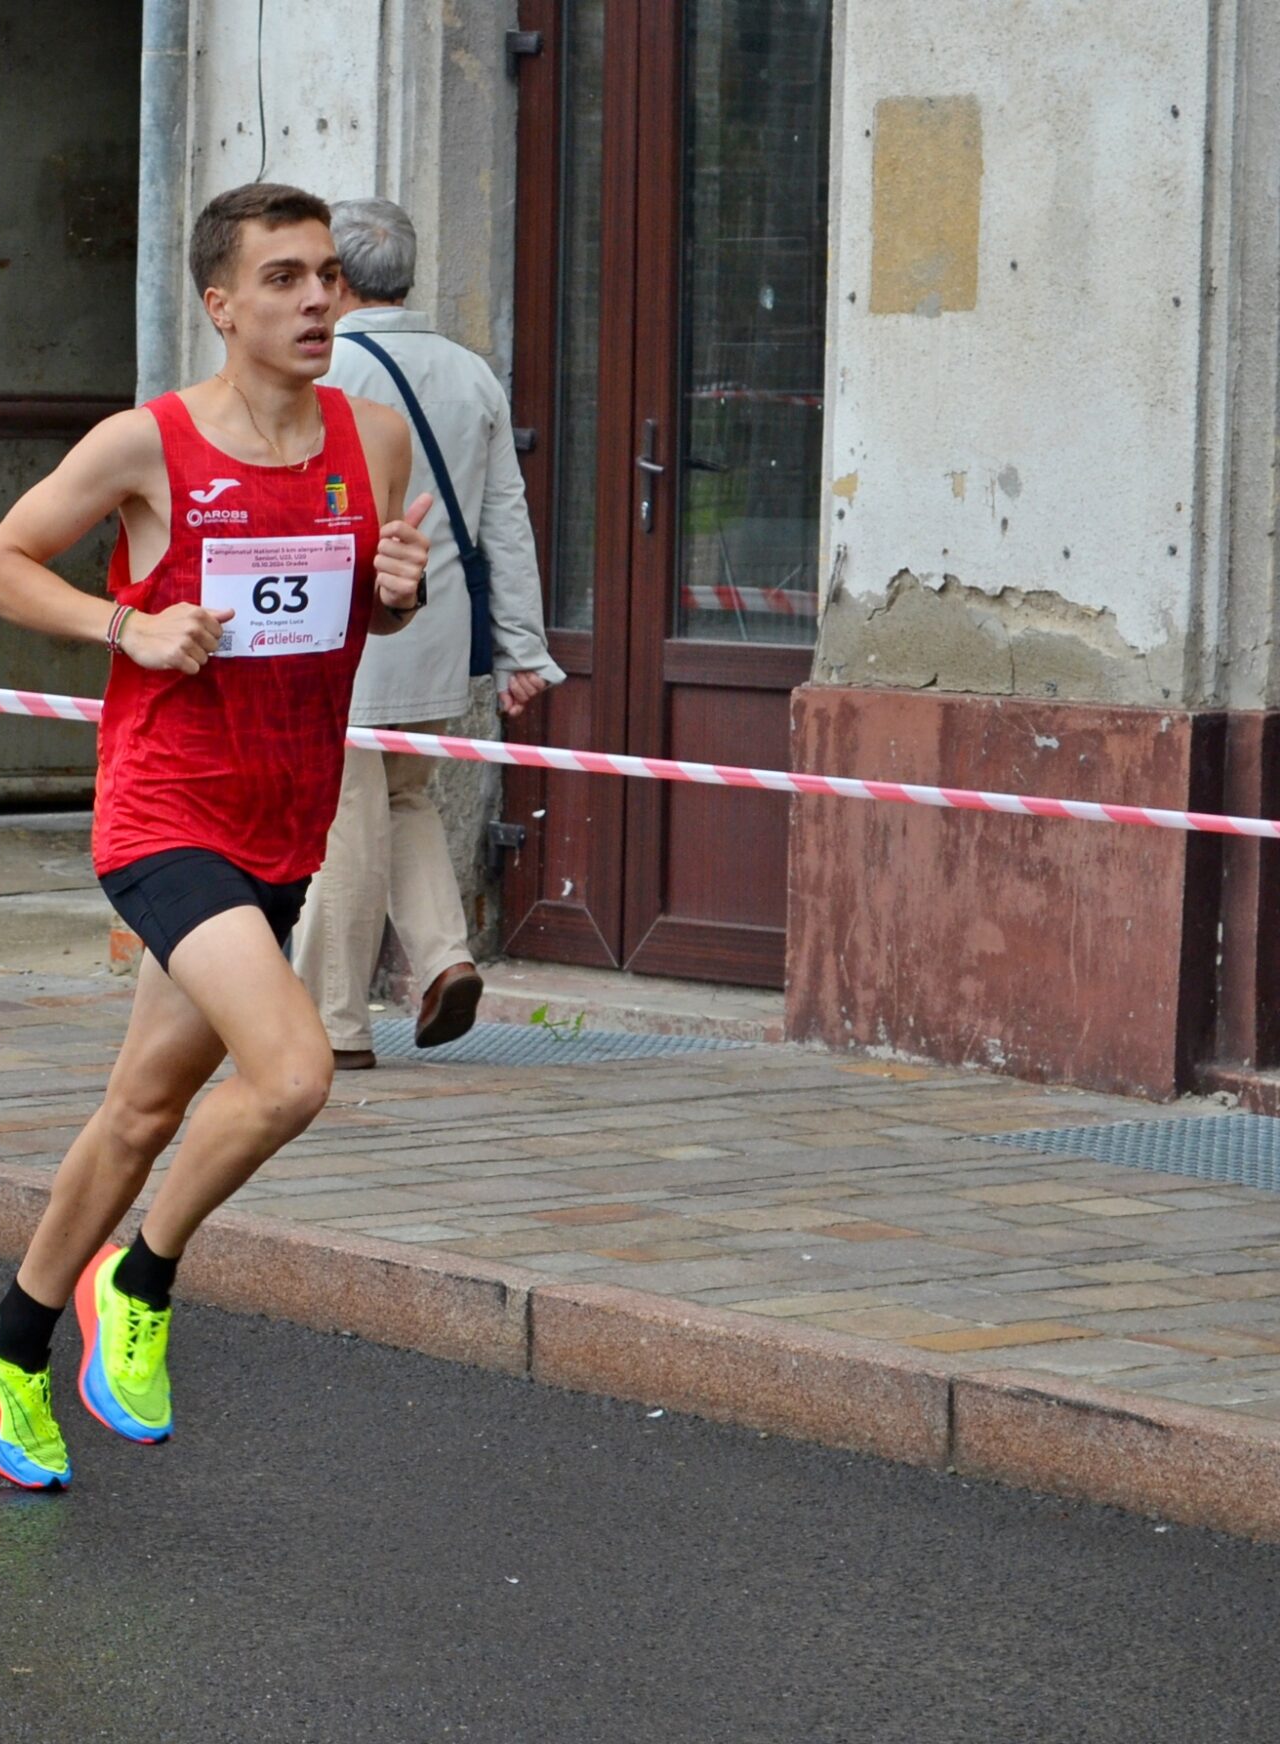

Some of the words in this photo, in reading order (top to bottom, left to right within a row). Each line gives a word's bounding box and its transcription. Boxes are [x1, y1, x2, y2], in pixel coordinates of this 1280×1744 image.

[204, 510, 248, 518] AROBS
[252, 575, 309, 614] 63
[267, 632, 313, 645] atletism
